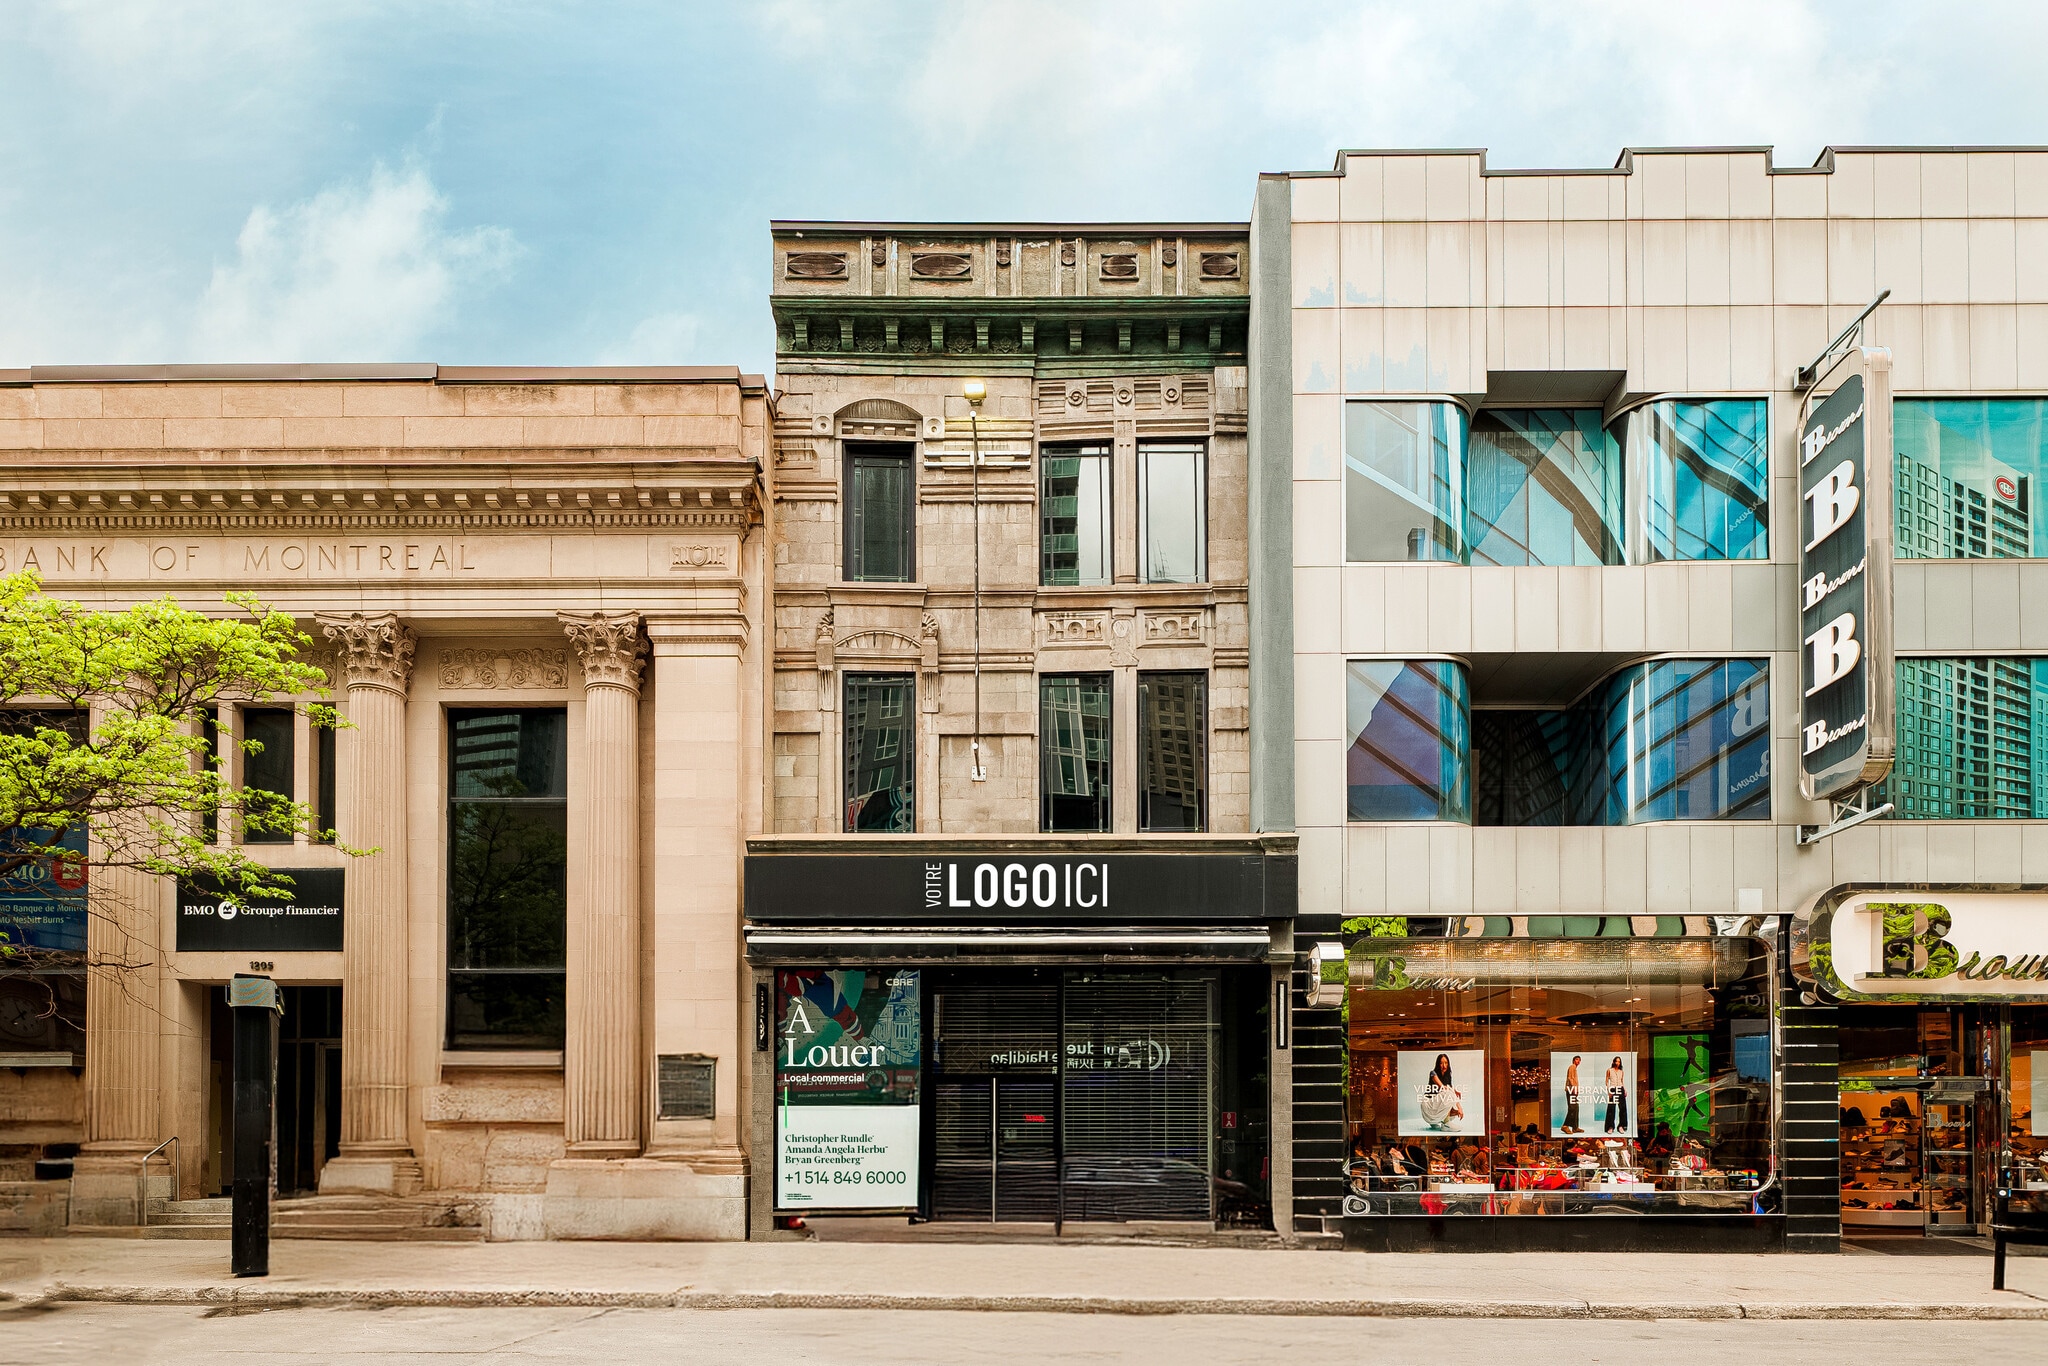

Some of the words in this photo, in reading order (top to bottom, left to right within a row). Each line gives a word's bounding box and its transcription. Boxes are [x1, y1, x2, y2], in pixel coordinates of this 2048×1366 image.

[1801, 403, 1864, 468] Browns
[1804, 459, 1860, 553] B
[152, 545, 200, 572] OF
[243, 544, 476, 572] MONTREAL
[1802, 556, 1866, 612] Browns
[1805, 612, 1861, 698] B
[1803, 714, 1866, 756] Browns
[6, 865, 46, 880] MO
[926, 862, 942, 908] VOTRE
[949, 863, 1057, 908] LOGO
[13, 904, 43, 914] Banque
[45, 904, 55, 912] de
[183, 905, 215, 916] BMO
[240, 904, 284, 917] Groupe
[285, 904, 340, 916] financier
[13, 916, 41, 924] Nesbitt
[43, 916, 65, 924] Burns
[885, 978, 914, 987] CBRE
[785, 996, 815, 1034] À
[784, 1037, 885, 1068] Louer
[784, 1073, 810, 1083] Local
[811, 1073, 865, 1083] commercial
[1566, 1085, 1623, 1095] VIBRANCE
[1569, 1095, 1620, 1105] ESTIVALE
[785, 1134, 839, 1144] Christopher
[785, 1145, 823, 1154] Amanda
[825, 1145, 856, 1155] Angela
[785, 1155, 812, 1165] Bryan
[785, 1171, 801, 1184] +1
[804, 1170, 830, 1184] 514
[833, 1170, 862, 1184] 849
[866, 1170, 907, 1184] 6000
